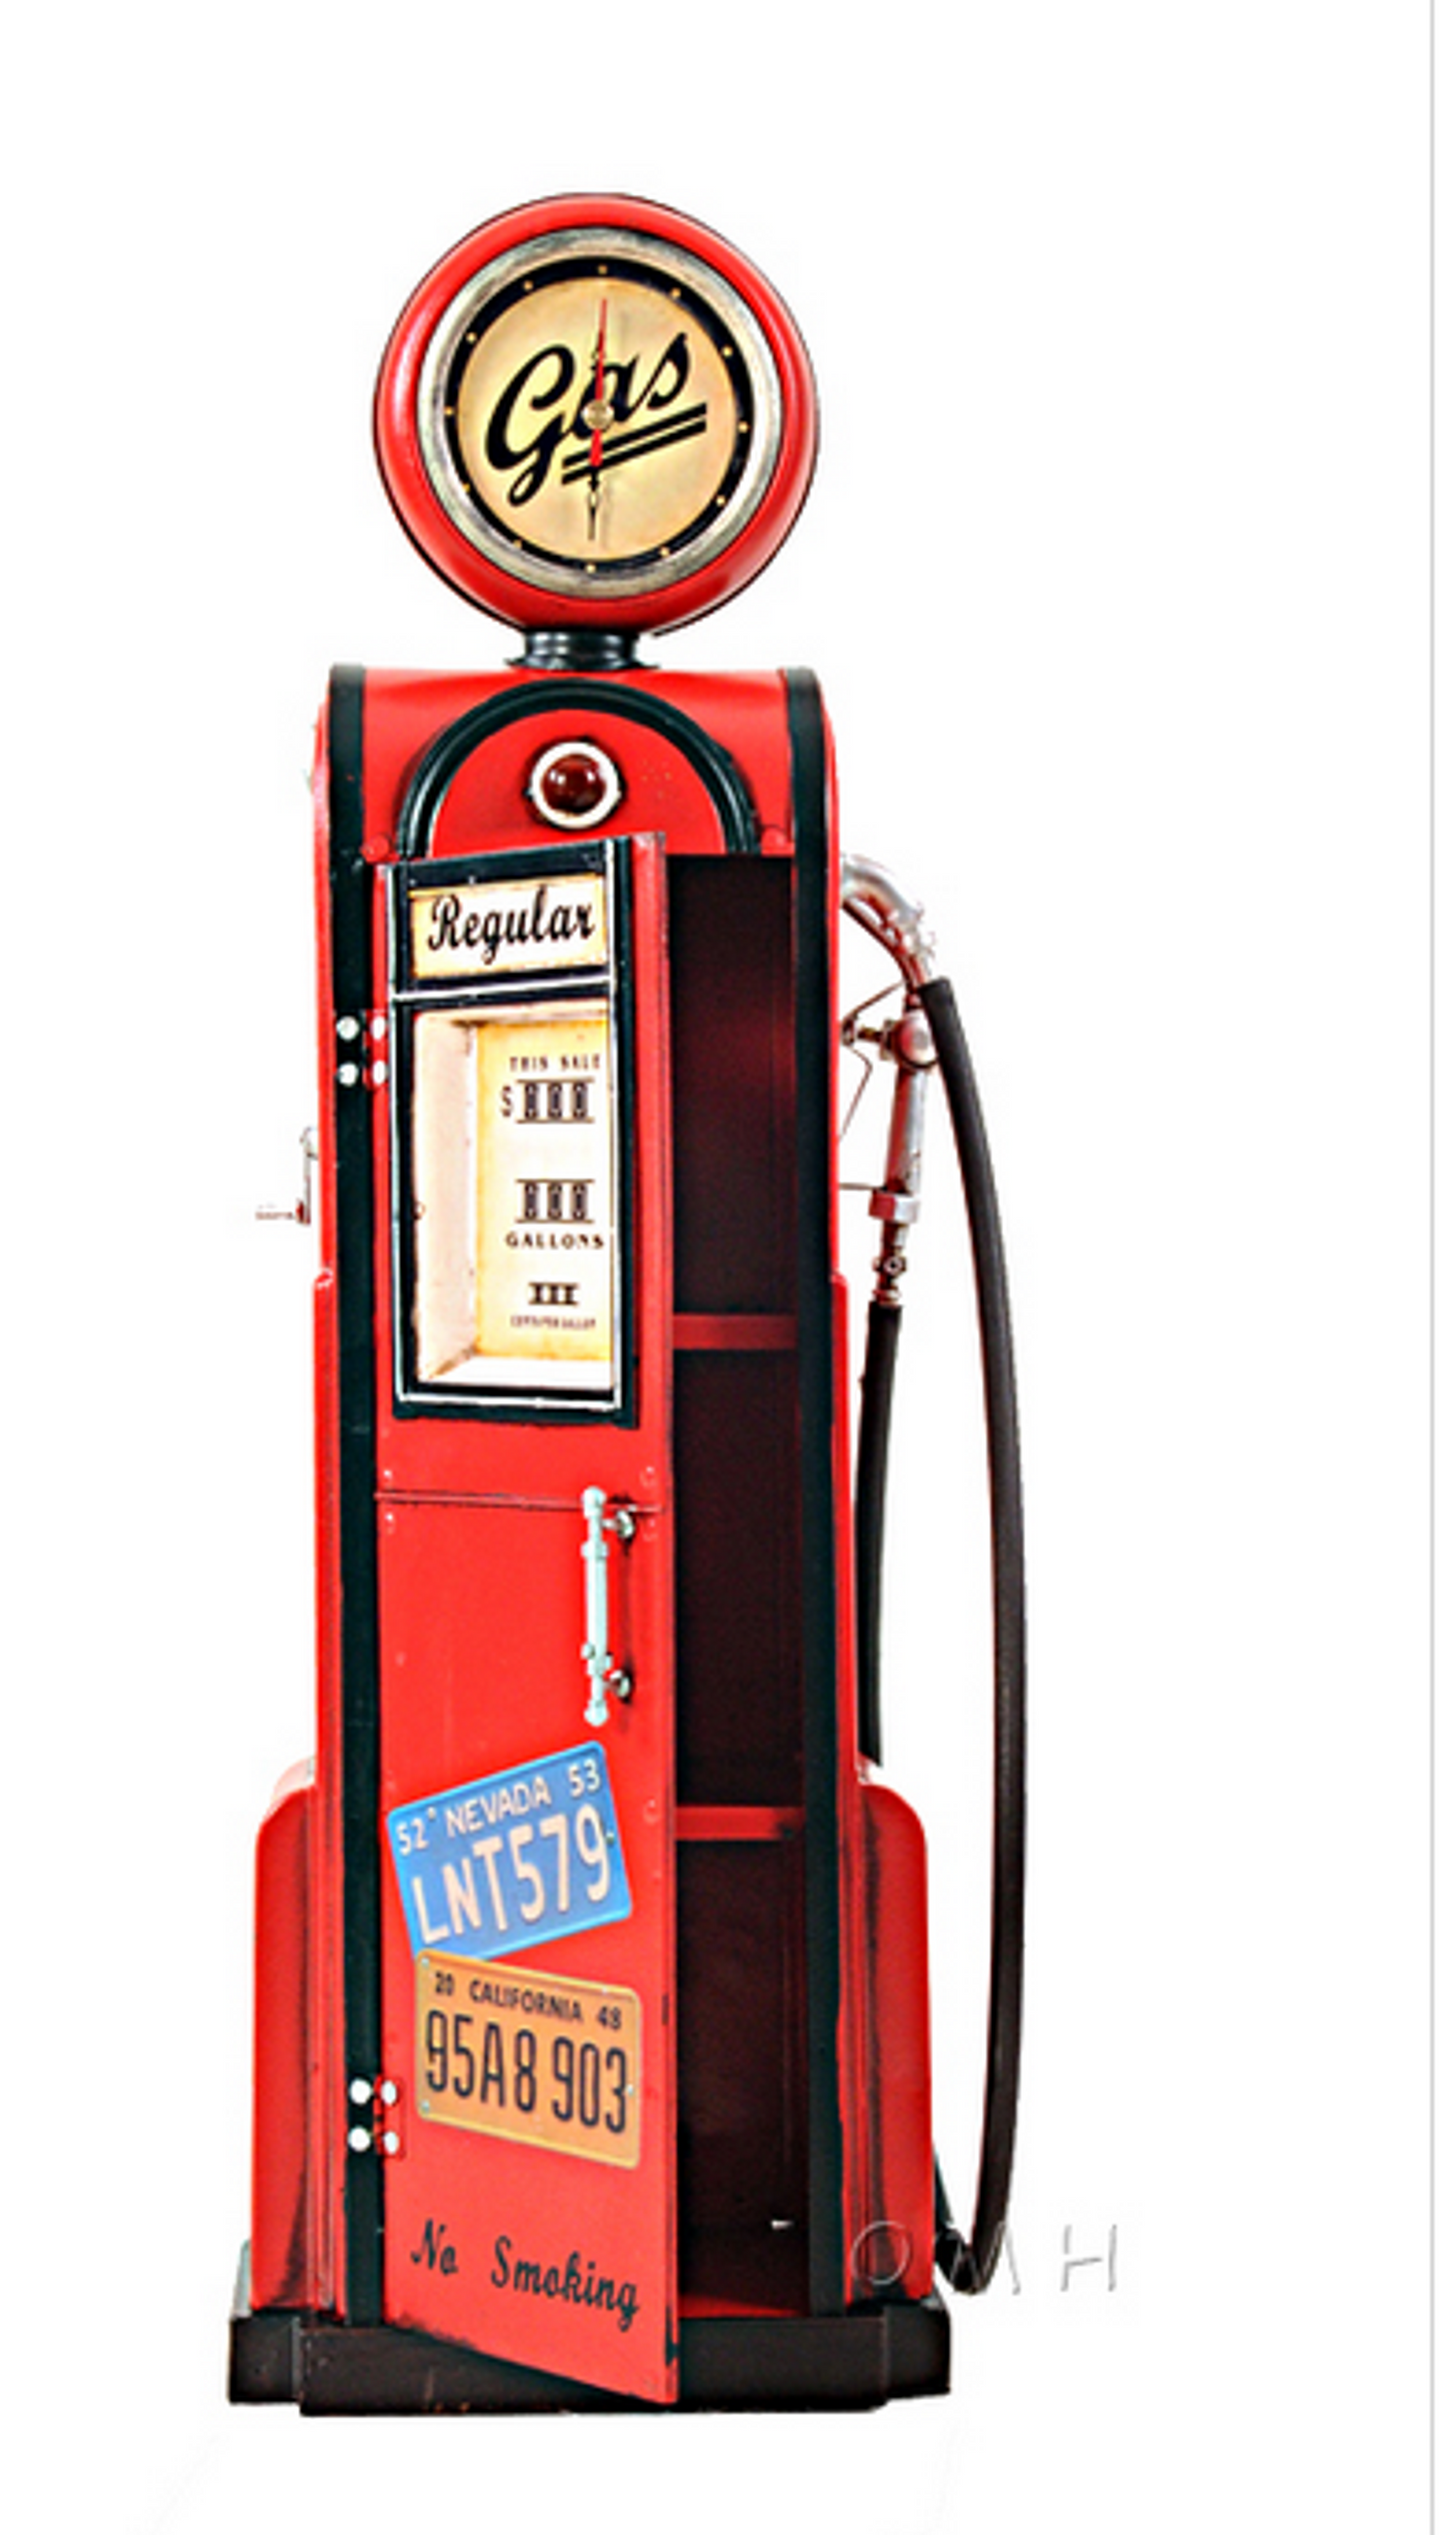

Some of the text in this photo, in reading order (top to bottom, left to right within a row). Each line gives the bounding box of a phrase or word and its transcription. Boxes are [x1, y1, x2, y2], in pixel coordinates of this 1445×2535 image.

[484, 332, 691, 507] Gas
[427, 884, 596, 965] Regular
[509, 1053, 601, 1072] THIS SALE
[505, 1231, 604, 1250] GALLONS
[396, 1758, 601, 1855] 52 NEVADA 53
[411, 1803, 611, 1945] LNT579
[469, 1979, 583, 2022] CALIFORNIA
[596, 2005, 622, 2030] 48
[410, 2217, 640, 2333] No Smoking
